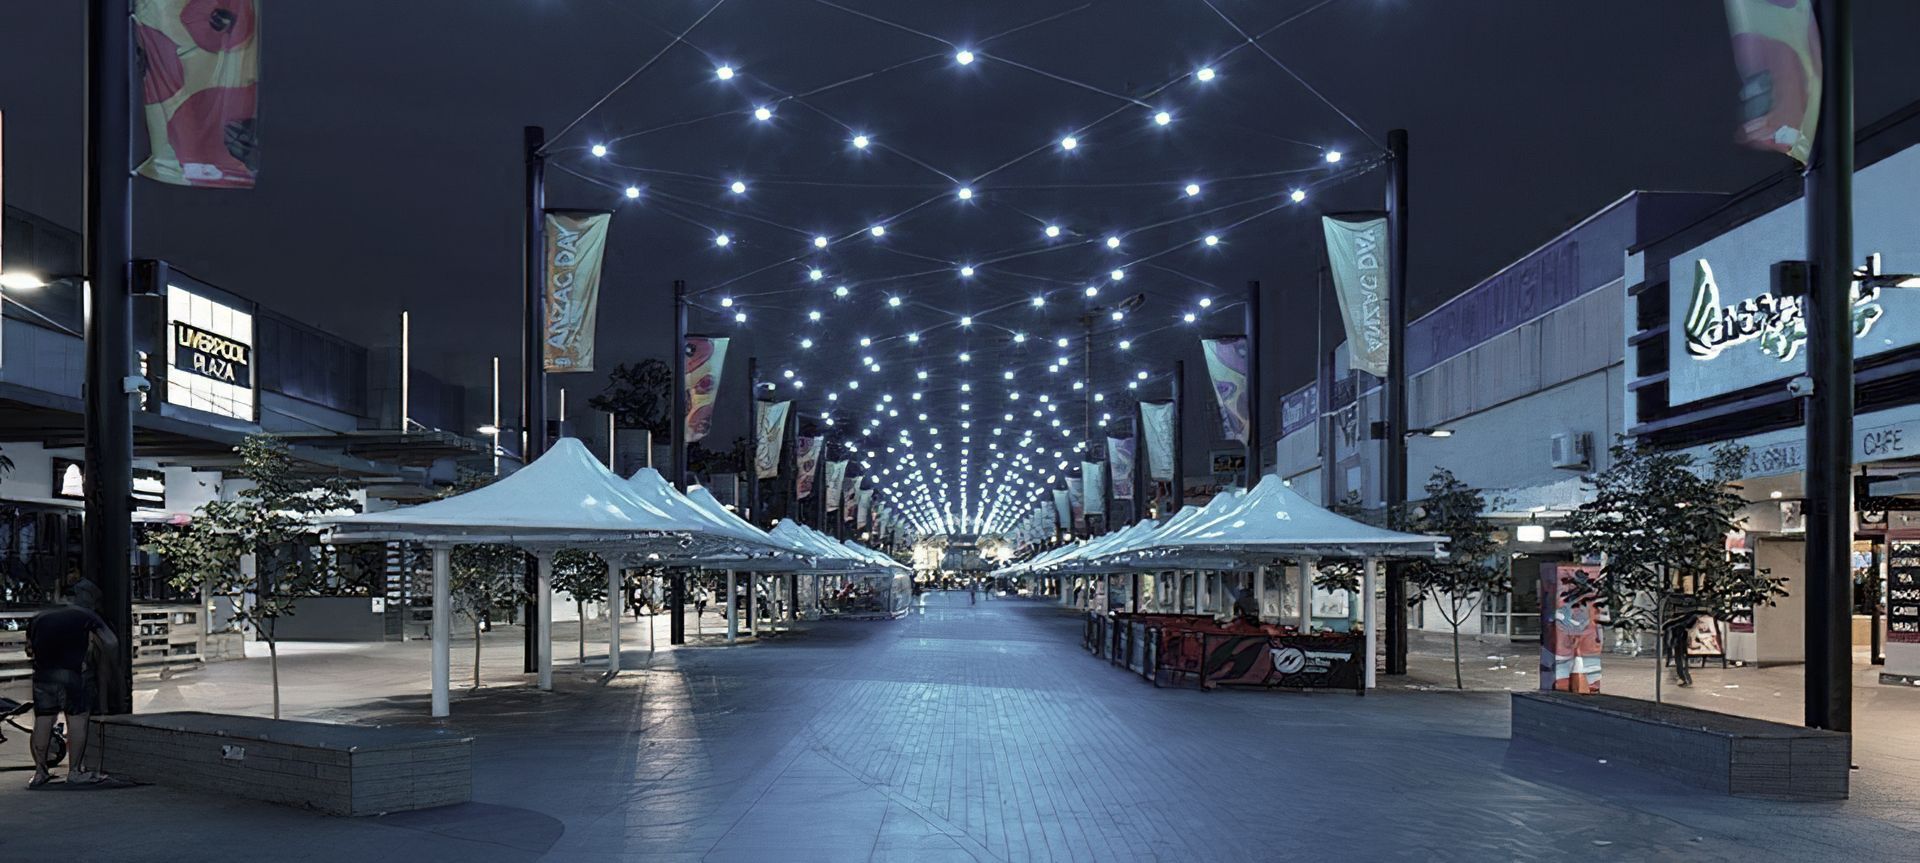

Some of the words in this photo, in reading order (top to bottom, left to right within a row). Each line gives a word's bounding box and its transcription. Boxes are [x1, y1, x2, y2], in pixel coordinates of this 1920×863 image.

[554, 226, 579, 267] DAY
[547, 270, 573, 350] ANZAC
[178, 325, 248, 366] LIVERPOOL
[193, 352, 235, 381] PLAZA
